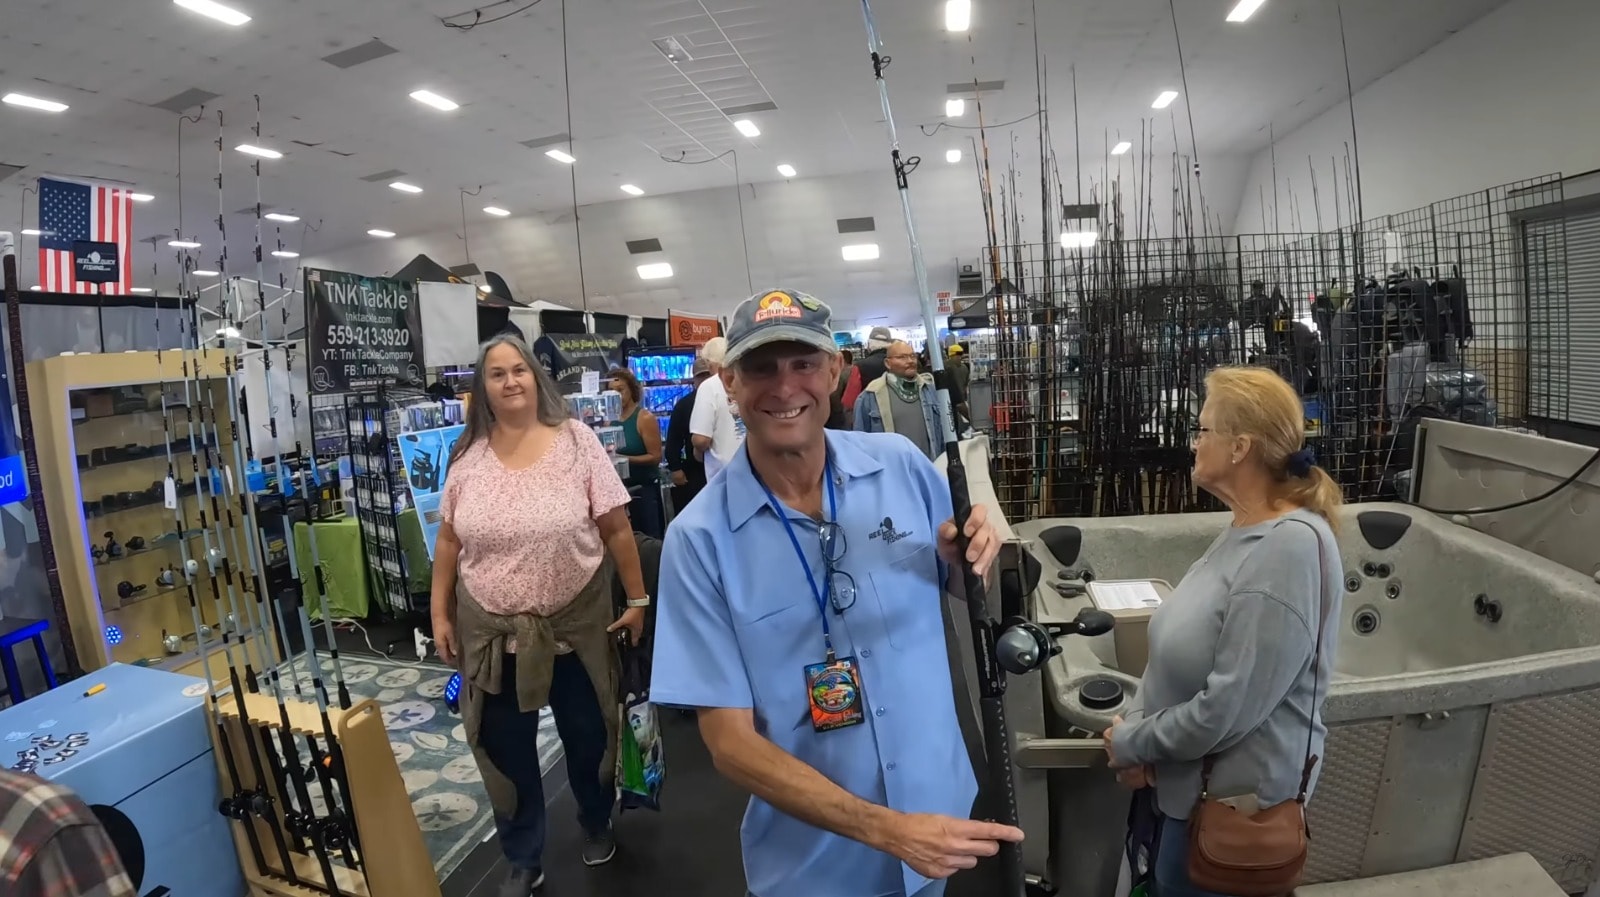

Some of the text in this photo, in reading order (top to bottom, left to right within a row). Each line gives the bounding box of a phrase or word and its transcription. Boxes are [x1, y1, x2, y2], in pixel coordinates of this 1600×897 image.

[324, 281, 408, 310] TNK Tackle
[345, 312, 393, 324] tnktackle.com
[327, 325, 410, 346] 559-213-3920
[322, 348, 414, 362] YT: TnkTackleCompany
[344, 363, 400, 376] FB: TnkTackle
[556, 366, 580, 382] ISLAND
